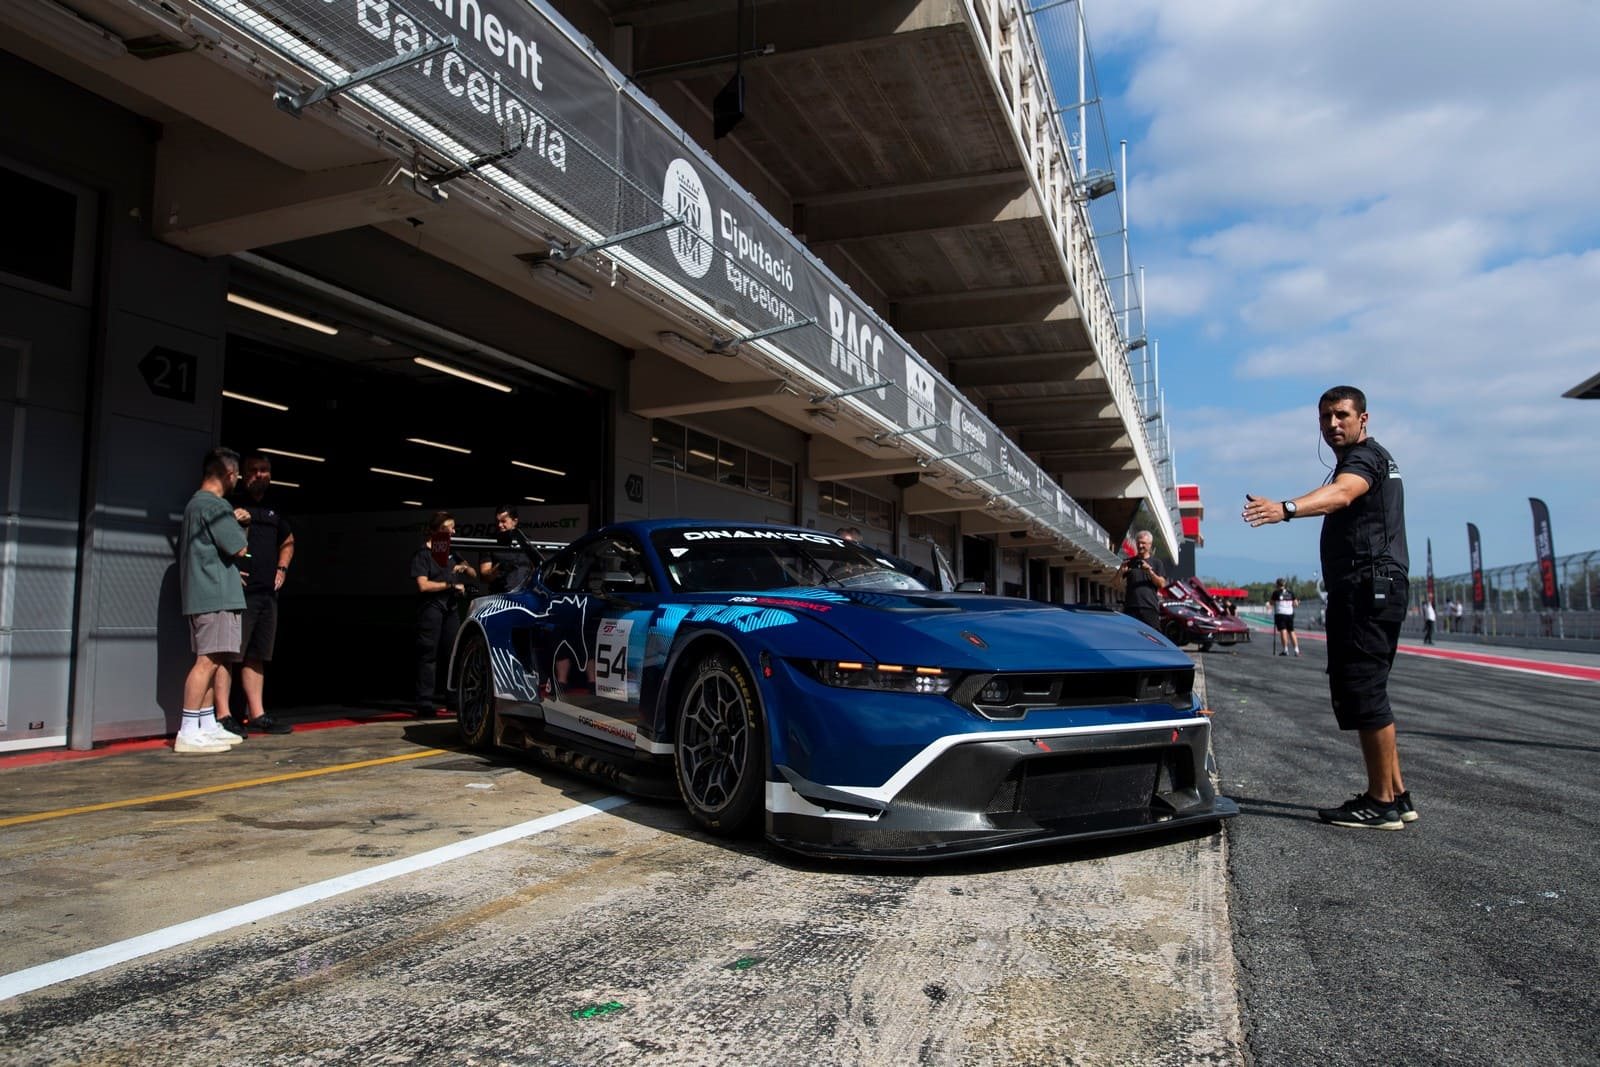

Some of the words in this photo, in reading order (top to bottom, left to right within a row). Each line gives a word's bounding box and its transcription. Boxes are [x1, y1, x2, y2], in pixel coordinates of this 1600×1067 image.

[720, 208, 794, 292] Diputació
[153, 355, 187, 392] 21
[829, 293, 886, 400] RACC
[597, 643, 627, 682] 54
